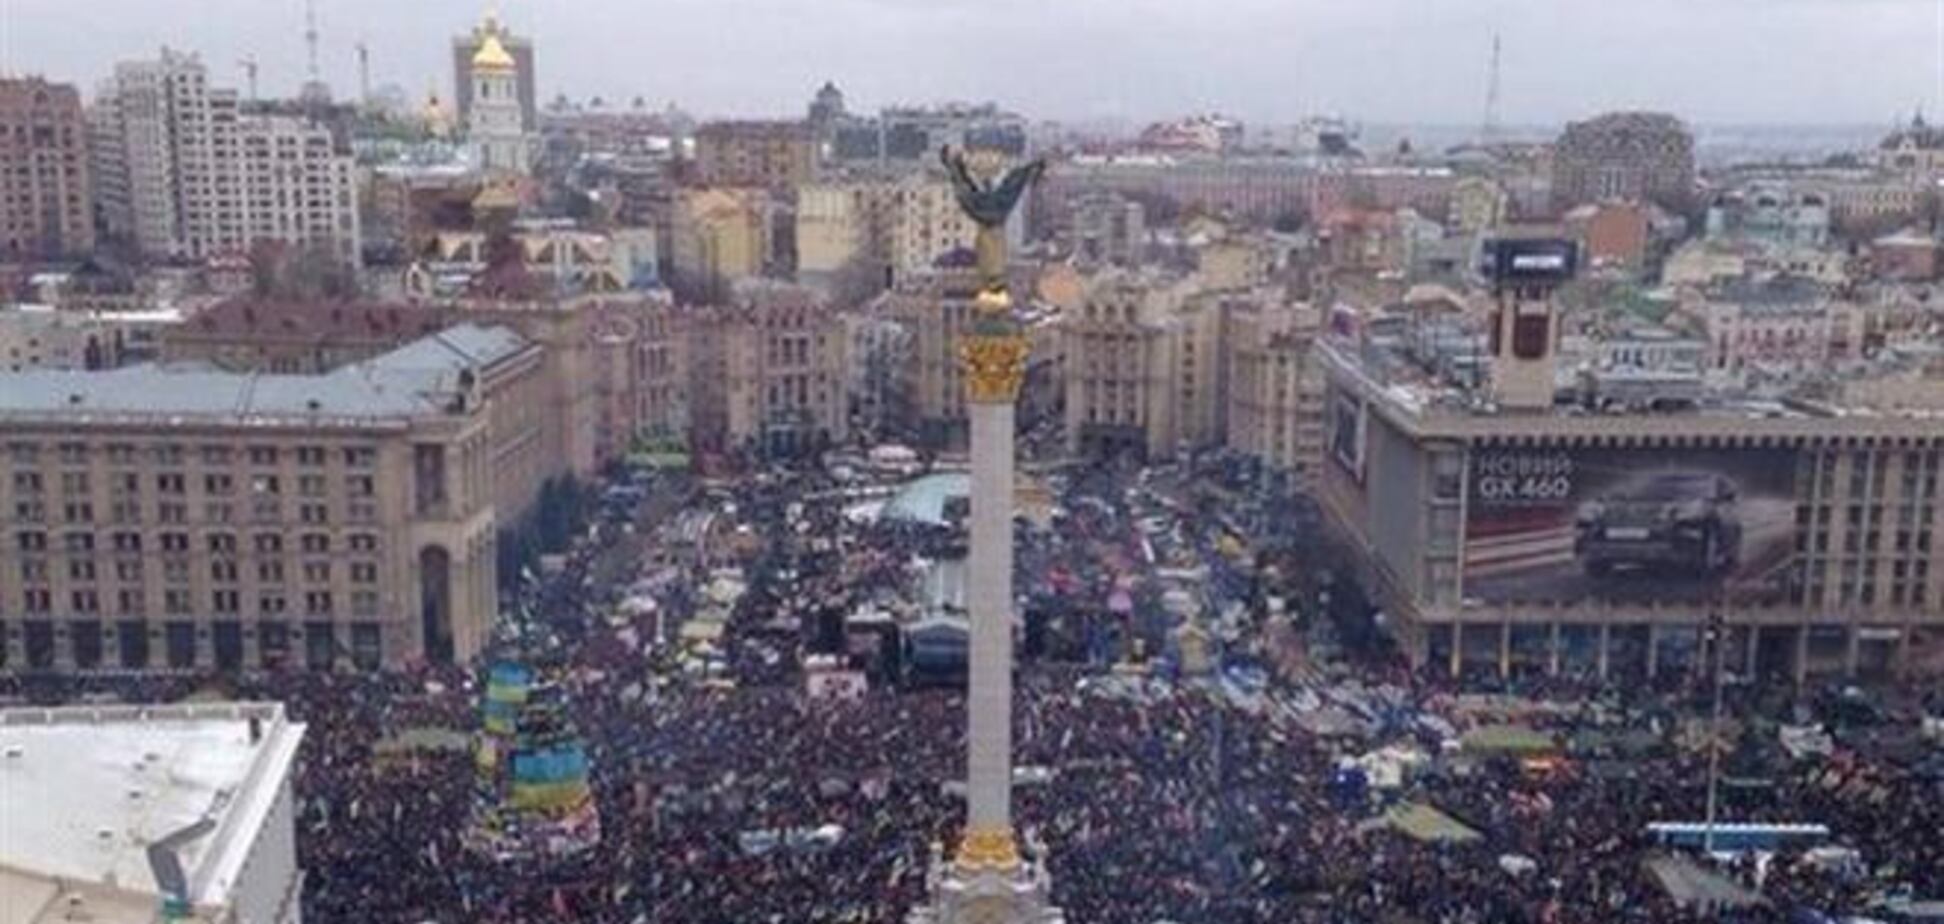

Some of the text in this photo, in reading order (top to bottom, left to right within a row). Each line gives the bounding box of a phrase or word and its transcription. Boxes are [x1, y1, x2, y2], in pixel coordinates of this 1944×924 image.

[1479, 453, 1571, 475] НОВИЙ
[1480, 477, 1570, 498] GX 460
